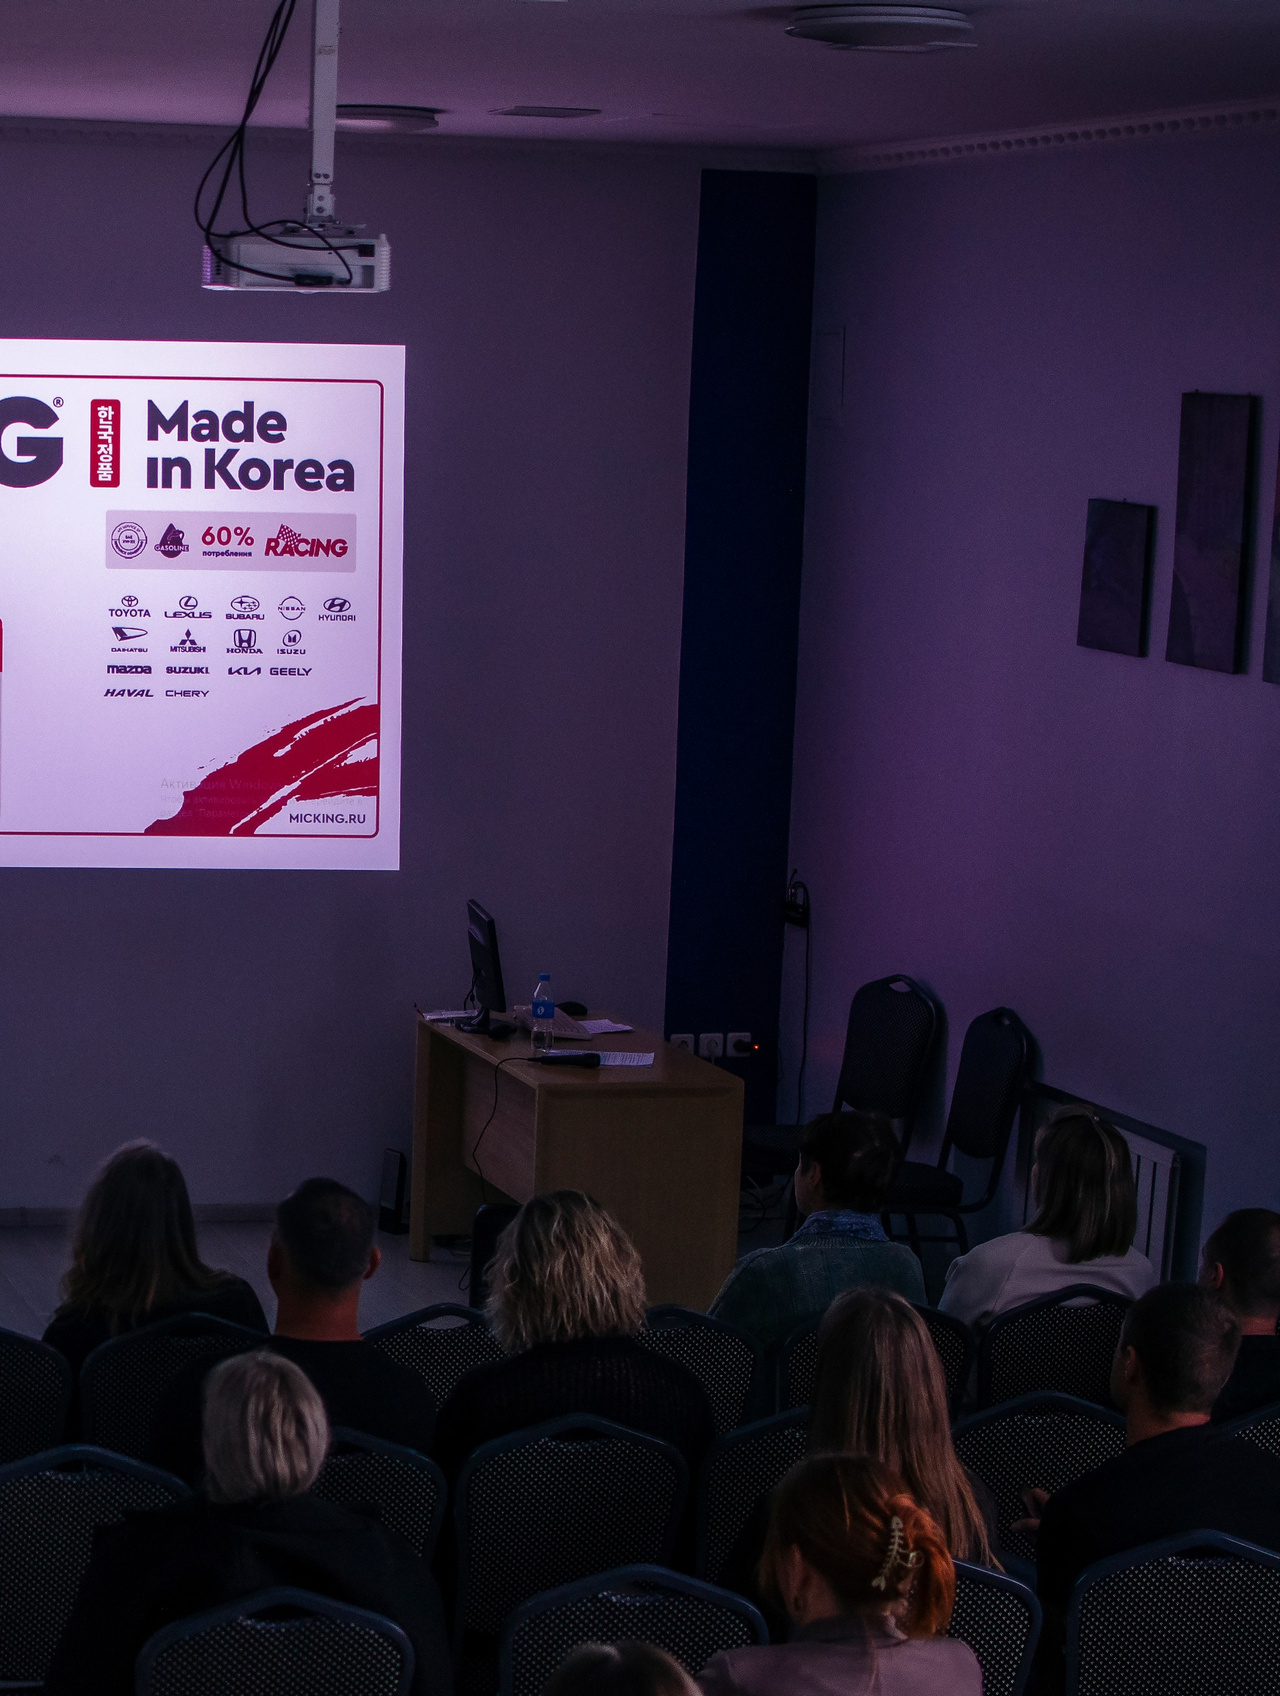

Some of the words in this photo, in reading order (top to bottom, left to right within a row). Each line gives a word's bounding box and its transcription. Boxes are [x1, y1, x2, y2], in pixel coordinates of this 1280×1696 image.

[147, 399, 287, 443] Made
[97, 405, 115, 482] 한국정품
[204, 448, 355, 492] Korea
[201, 526, 255, 547] 60%
[154, 544, 189, 552] GASOLINE
[202, 549, 253, 558] потребления
[264, 536, 348, 558] RACING
[108, 608, 151, 618] TOYOTA
[164, 611, 213, 619] LEXUS
[225, 613, 265, 621] SUBARU
[318, 614, 356, 622] HYUNDAI
[165, 666, 210, 675] SUZUKI
[269, 667, 313, 676] GEELY
[103, 688, 155, 698] HAVAL
[165, 689, 210, 698] CHERY
[289, 813, 366, 824] MICKING.RU
